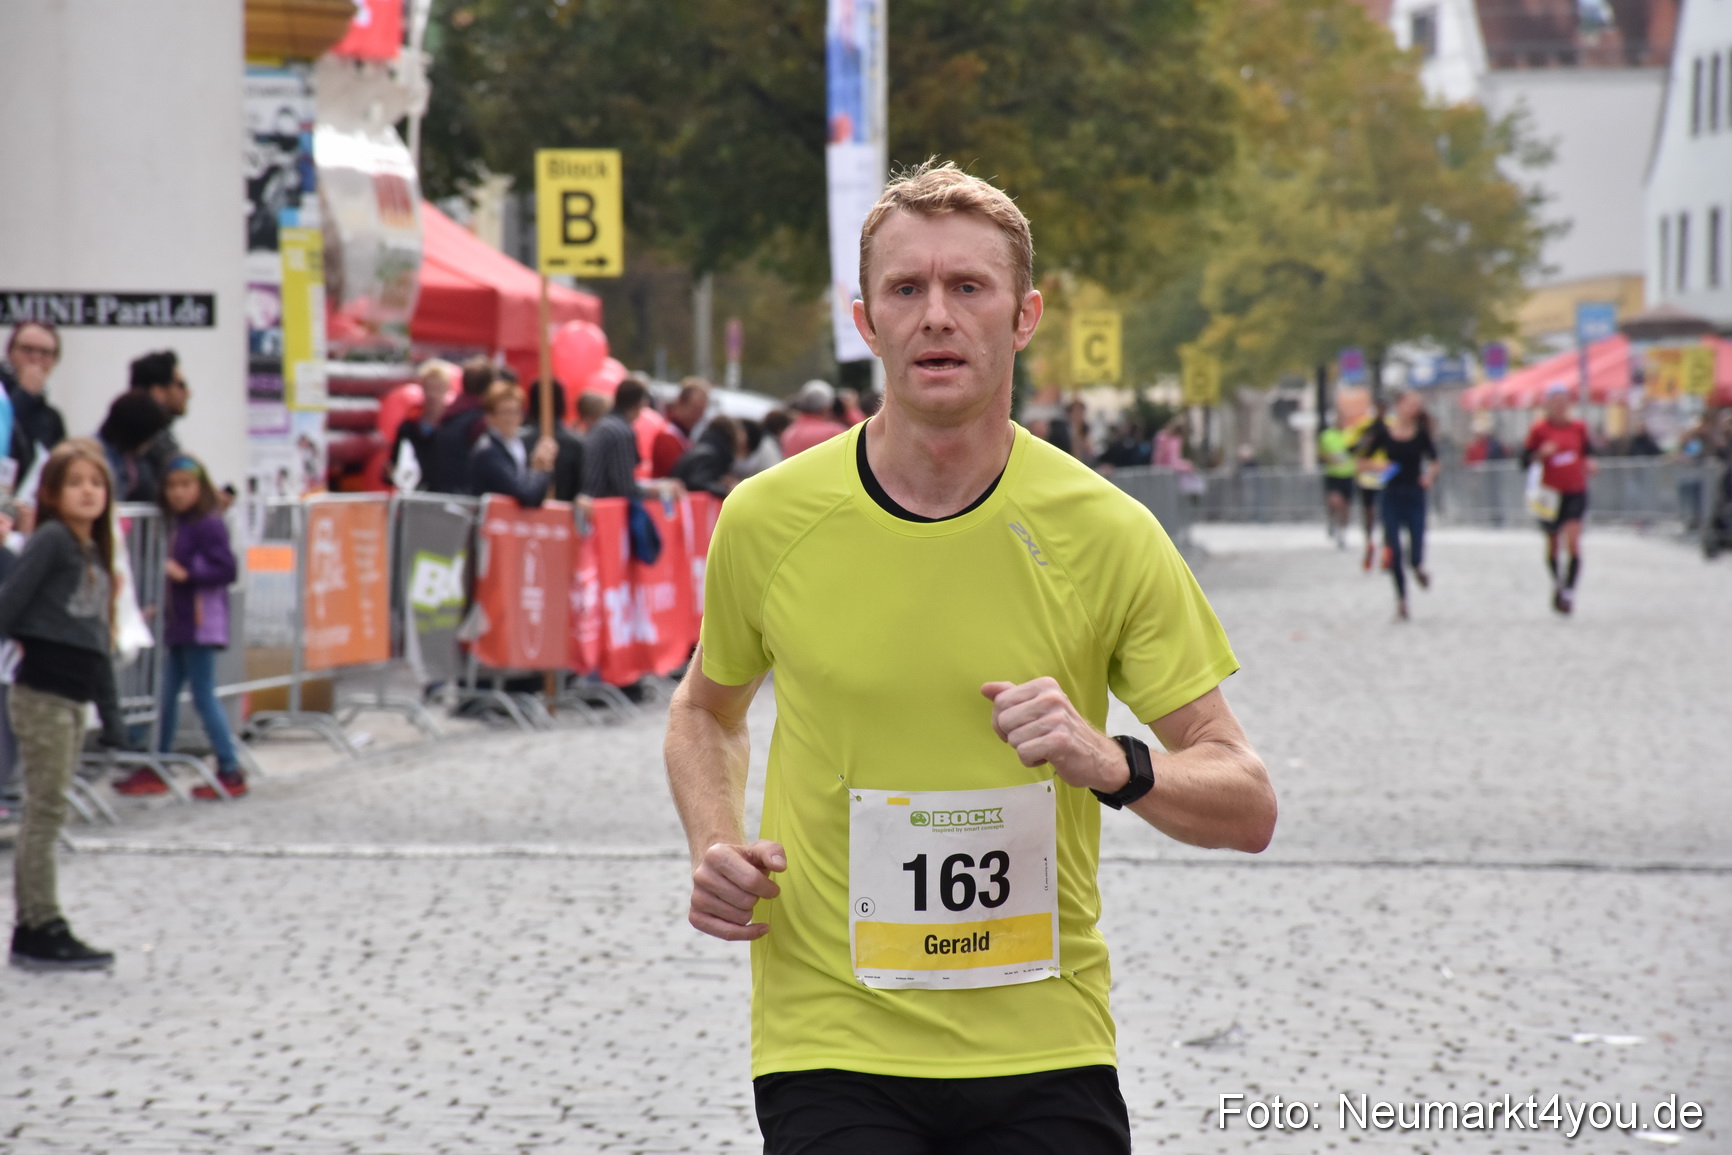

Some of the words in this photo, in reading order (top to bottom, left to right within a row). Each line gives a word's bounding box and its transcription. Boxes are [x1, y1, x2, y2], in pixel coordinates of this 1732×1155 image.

[561, 191, 598, 244] B
[1082, 332, 1108, 367] C
[932, 807, 1003, 827] BOCK
[903, 850, 1011, 911] 163
[861, 902, 869, 912] C
[924, 931, 990, 955] Gerald
